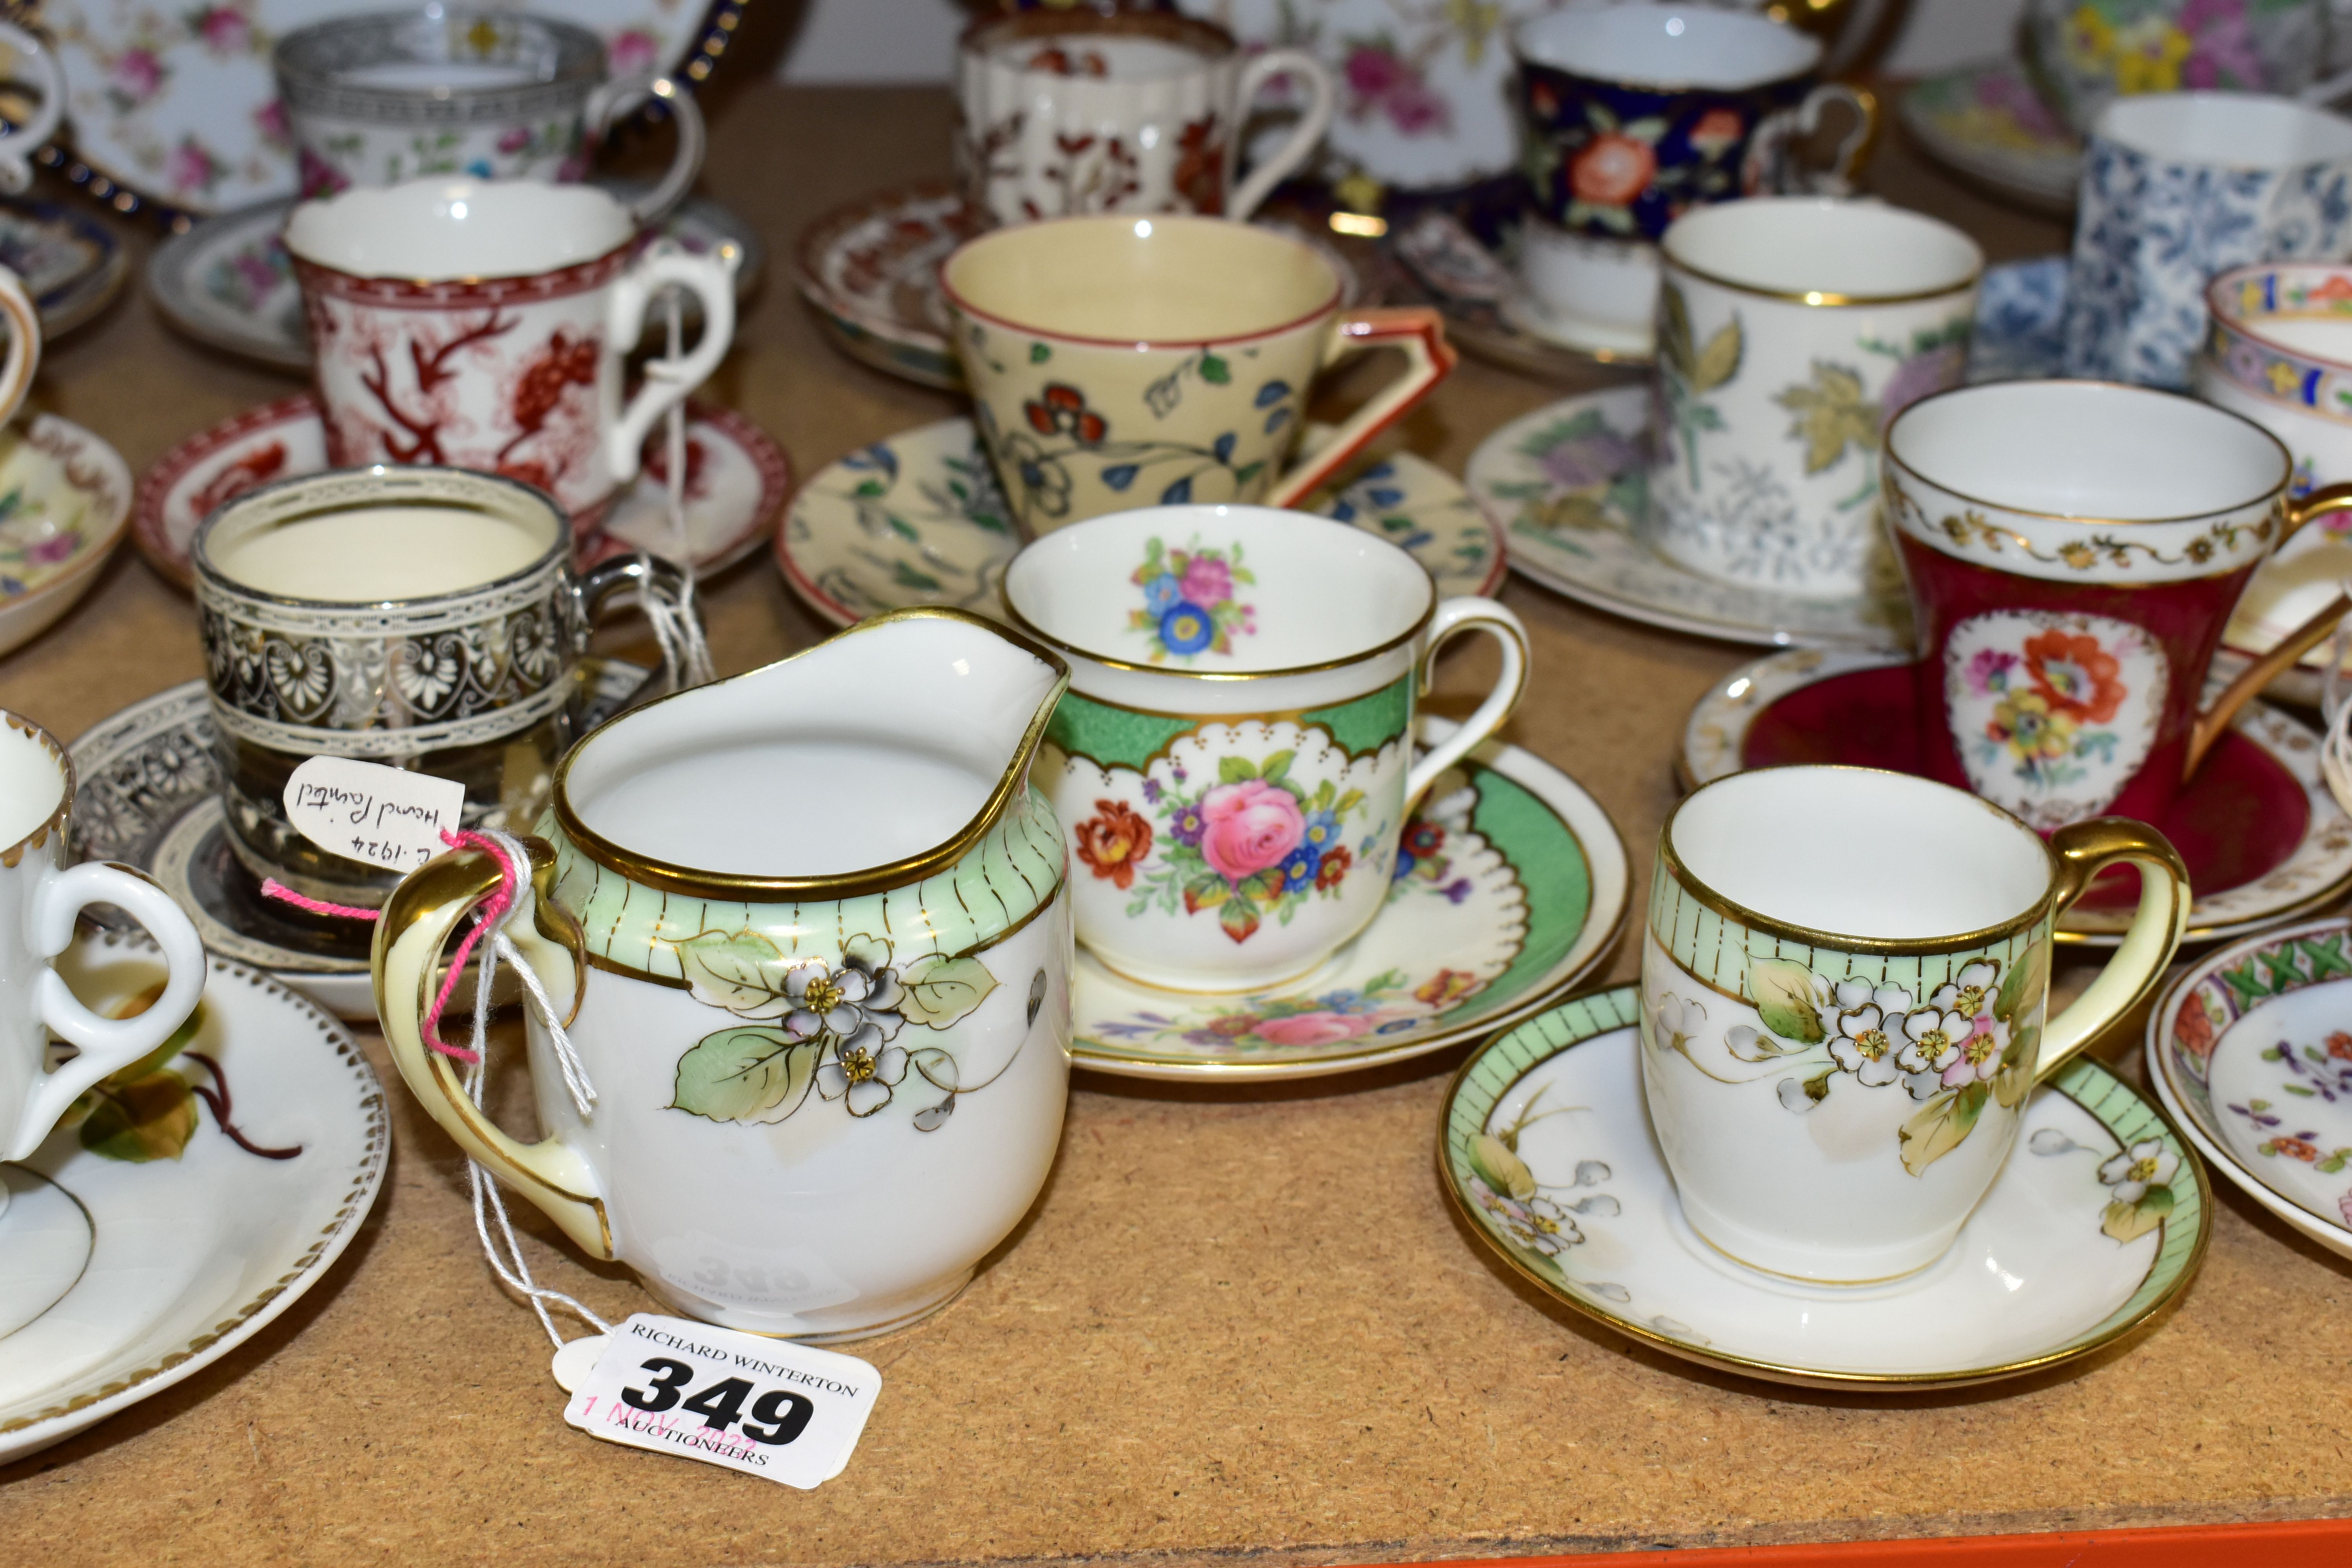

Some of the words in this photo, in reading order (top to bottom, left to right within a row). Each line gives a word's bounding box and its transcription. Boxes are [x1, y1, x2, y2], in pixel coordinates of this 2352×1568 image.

[297, 783, 372, 824] Painted
[376, 802, 439, 828] Hand
[632, 1323, 728, 1361] RICHARD
[735, 1354, 860, 1398] WINTERTON
[583, 1396, 598, 1416] 1
[606, 1402, 680, 1436] NOV
[621, 1357, 814, 1446] 349
[614, 1417, 770, 1465] AUCTIONEERS
